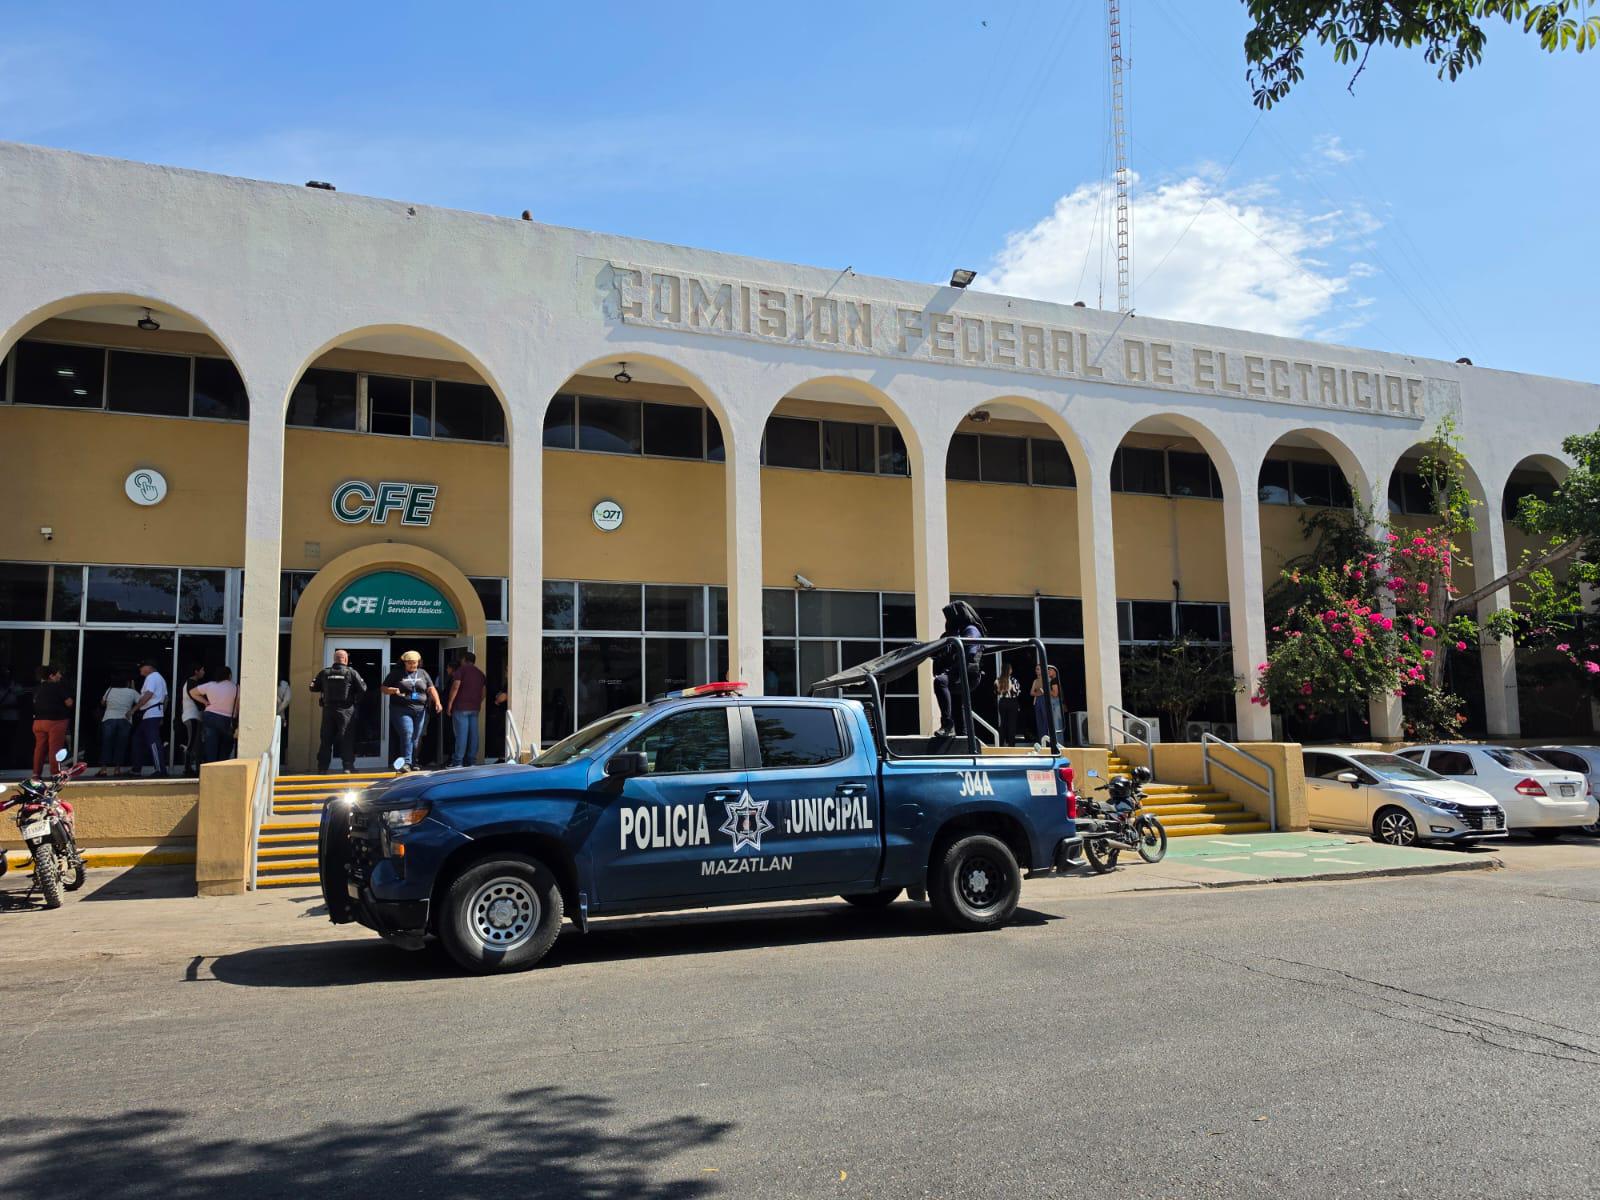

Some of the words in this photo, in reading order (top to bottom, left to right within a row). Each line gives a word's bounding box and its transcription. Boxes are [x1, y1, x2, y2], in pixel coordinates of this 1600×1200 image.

[897, 306, 1103, 377] FEDERAL
[1123, 338, 1174, 385] DE
[331, 480, 438, 527] CFE
[342, 596, 378, 614] CFE
[387, 606, 416, 614] Servicios
[433, 598, 442, 606] de
[620, 803, 711, 850] POLICIA
[784, 796, 873, 834] UNICIPAL
[700, 855, 793, 876] MAZATLAN
